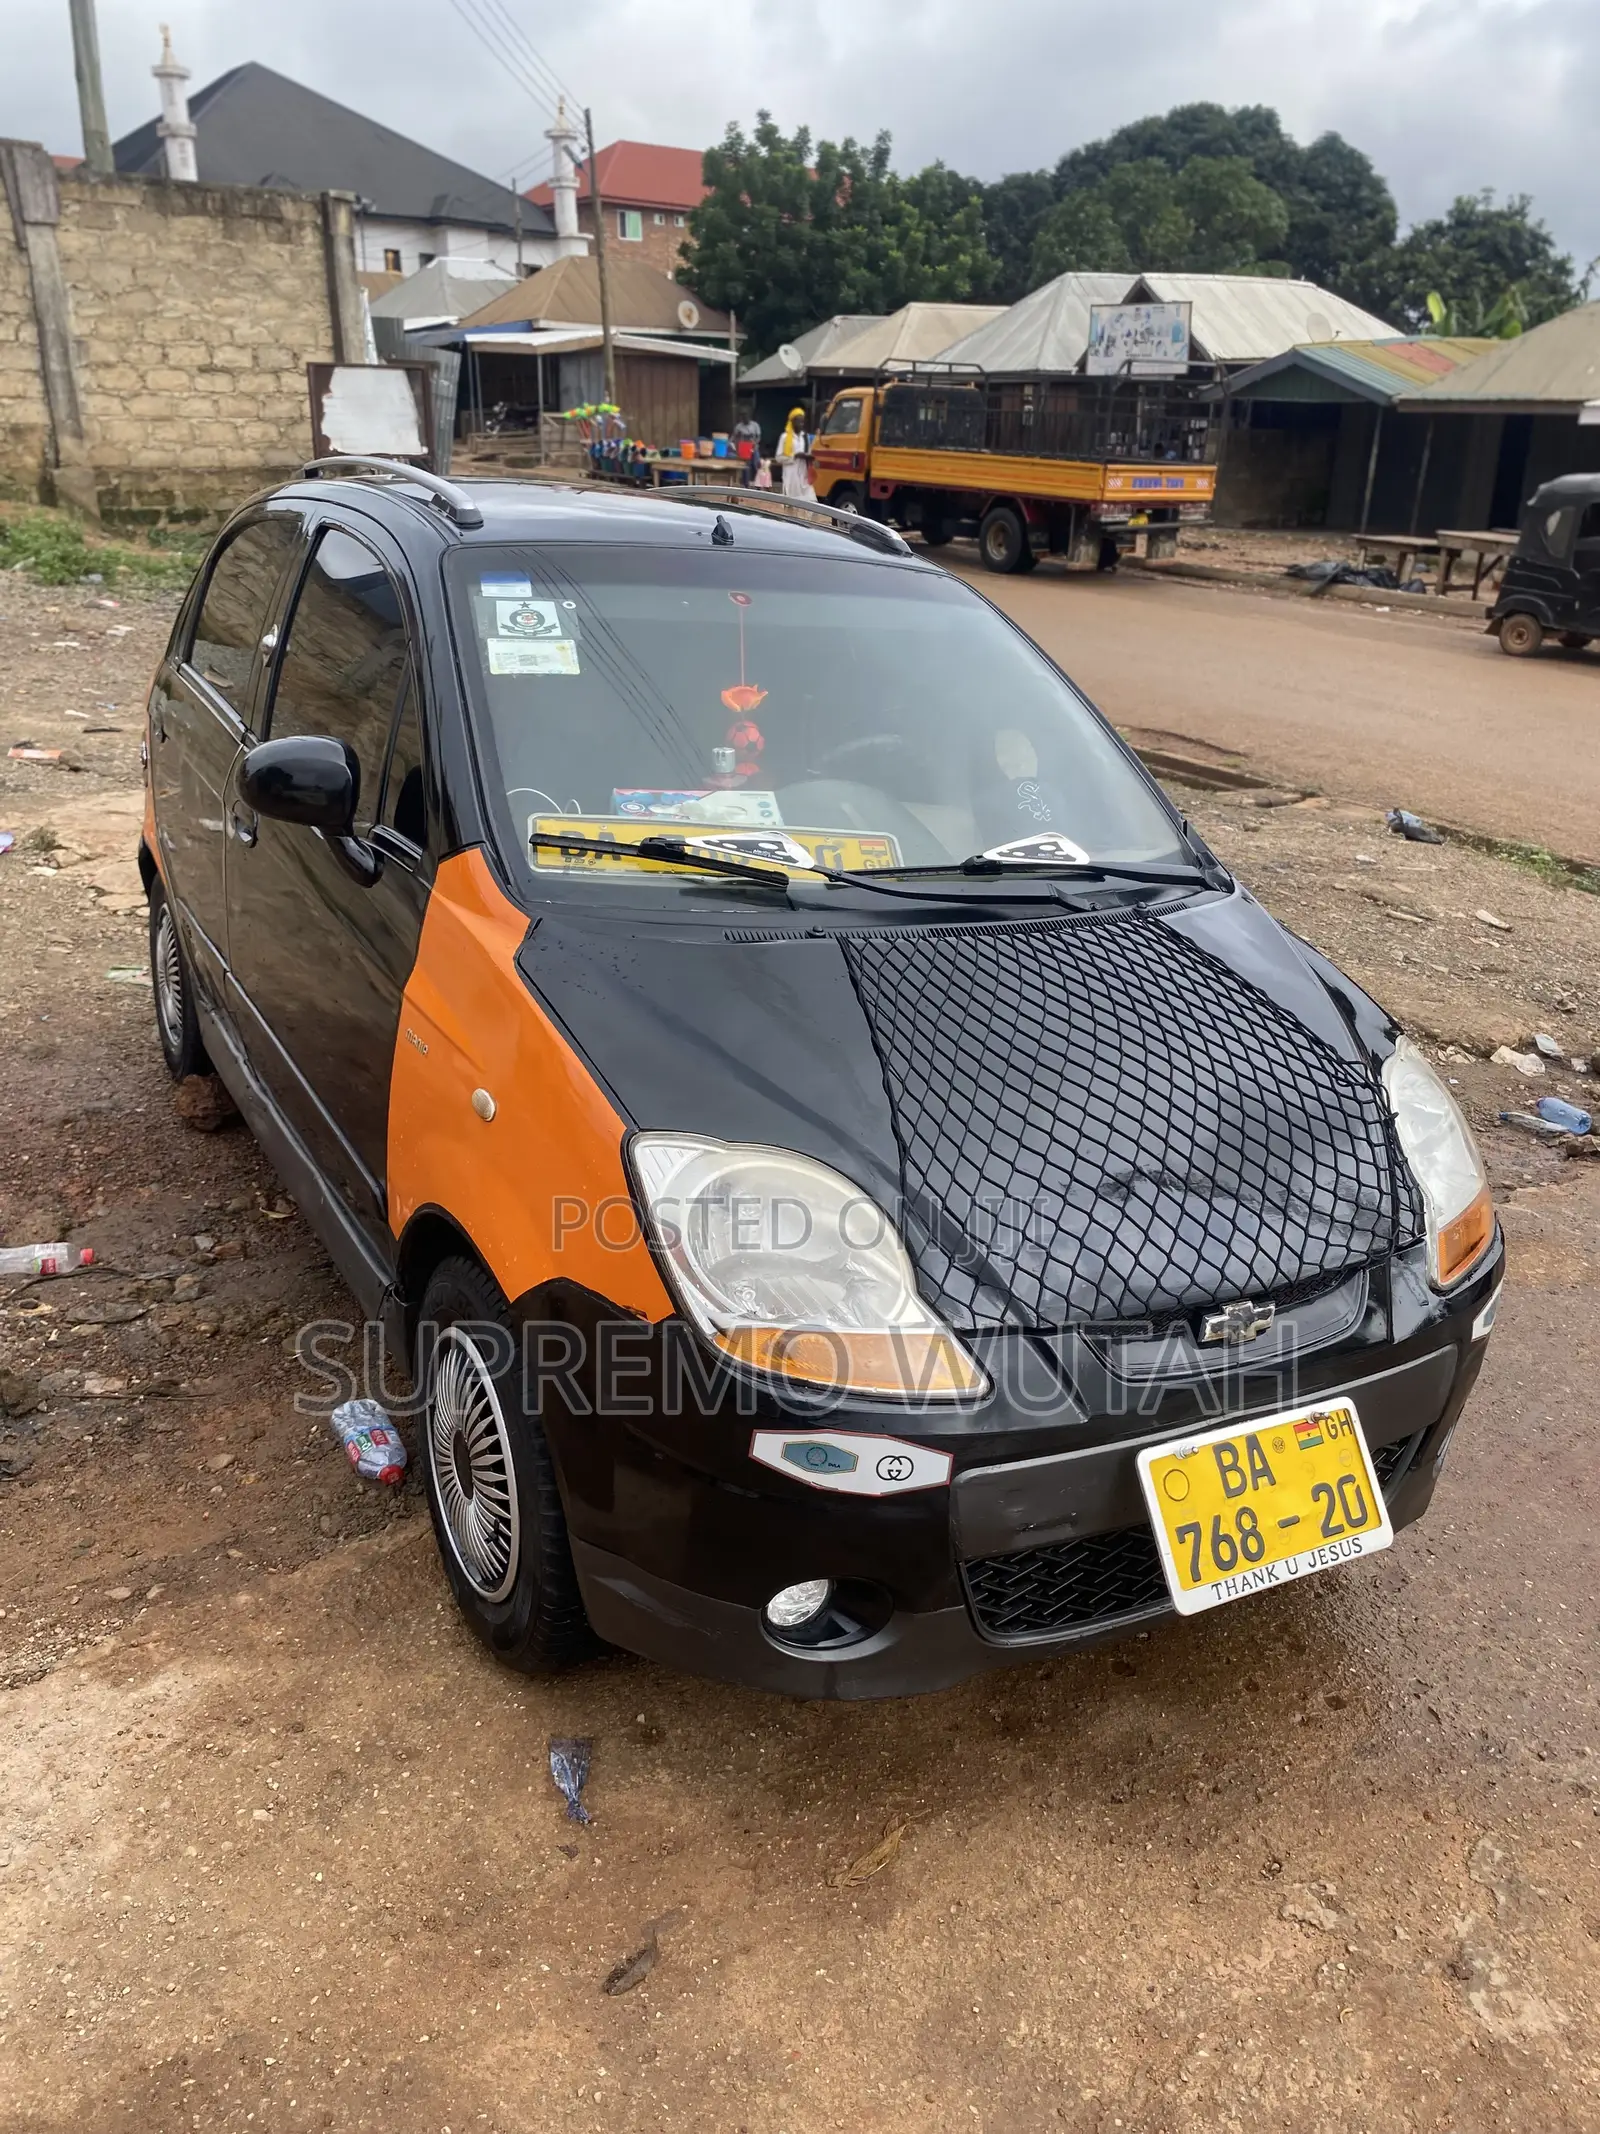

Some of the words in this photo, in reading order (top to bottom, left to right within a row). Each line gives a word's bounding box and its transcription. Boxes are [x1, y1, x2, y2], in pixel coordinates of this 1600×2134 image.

[1324, 1410, 1353, 1440] GH
[1212, 1435, 1276, 1498] BA
[1175, 1506, 1265, 1582] 768
[1311, 1473, 1368, 1539] 20
[1211, 1564, 1281, 1601] THANK
[1286, 1560, 1299, 1575] U
[1307, 1537, 1363, 1569] JESUS
